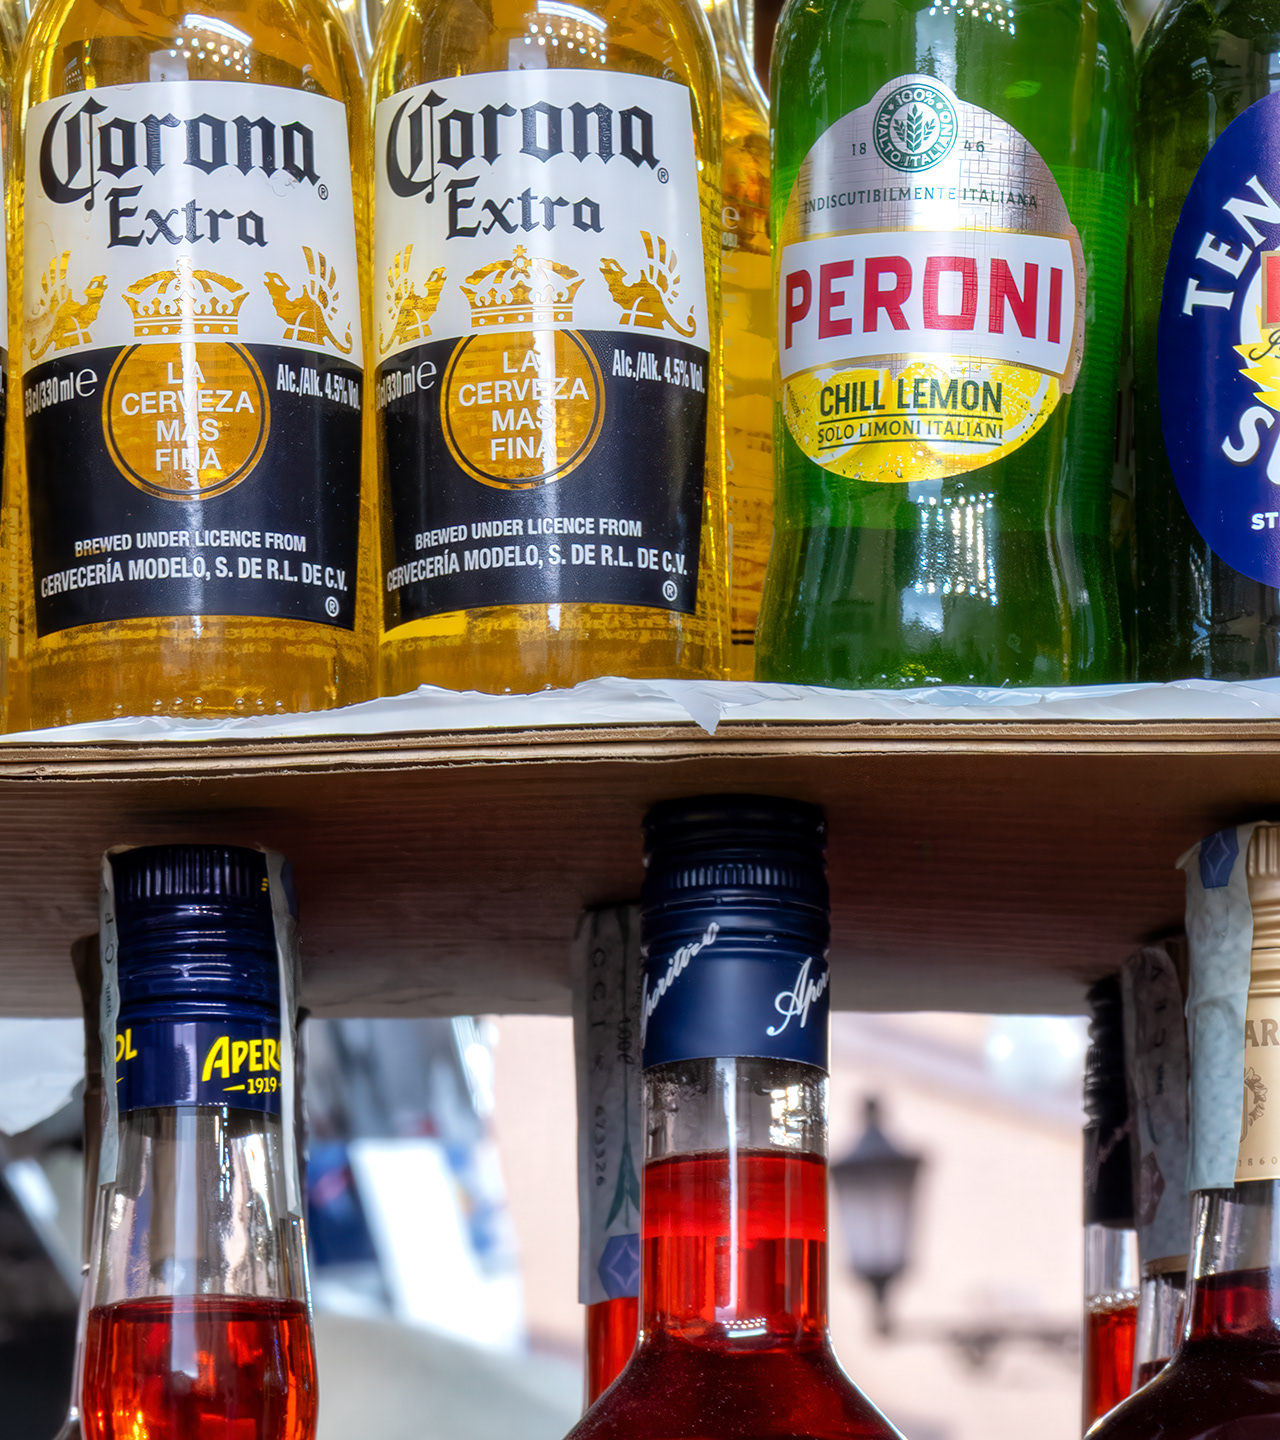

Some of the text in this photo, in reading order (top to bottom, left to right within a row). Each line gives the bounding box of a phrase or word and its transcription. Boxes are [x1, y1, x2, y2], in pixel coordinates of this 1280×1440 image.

[894, 87, 936, 107] 100%
[40, 97, 320, 209] Corona
[386, 89, 661, 204] Corona
[851, 142, 867, 156] 18
[963, 139, 986, 153] 46
[445, 176, 605, 241] Extra
[804, 187, 1038, 214] INDISCUTIBILMENTE ITALIANA
[106, 185, 269, 249] Extra
[784, 255, 1063, 351] PERONI
[167, 362, 206, 385] LA
[503, 350, 542, 373] LA
[612, 349, 662, 382] Alc./Alk.
[277, 364, 323, 396] Alc./Alk.
[458, 378, 590, 407] CERVEZA
[121, 390, 255, 416] CERVEZA
[820, 381, 889, 417] CHILL
[897, 378, 1003, 411] LEMON
[157, 418, 219, 442] MAS
[492, 408, 554, 432] MAS
[818, 419, 1003, 444] SOLO LIMONI ITALIANI
[156, 448, 222, 472] FINA
[491, 436, 555, 461] FINA
[247, 1077, 277, 1094] 1919
